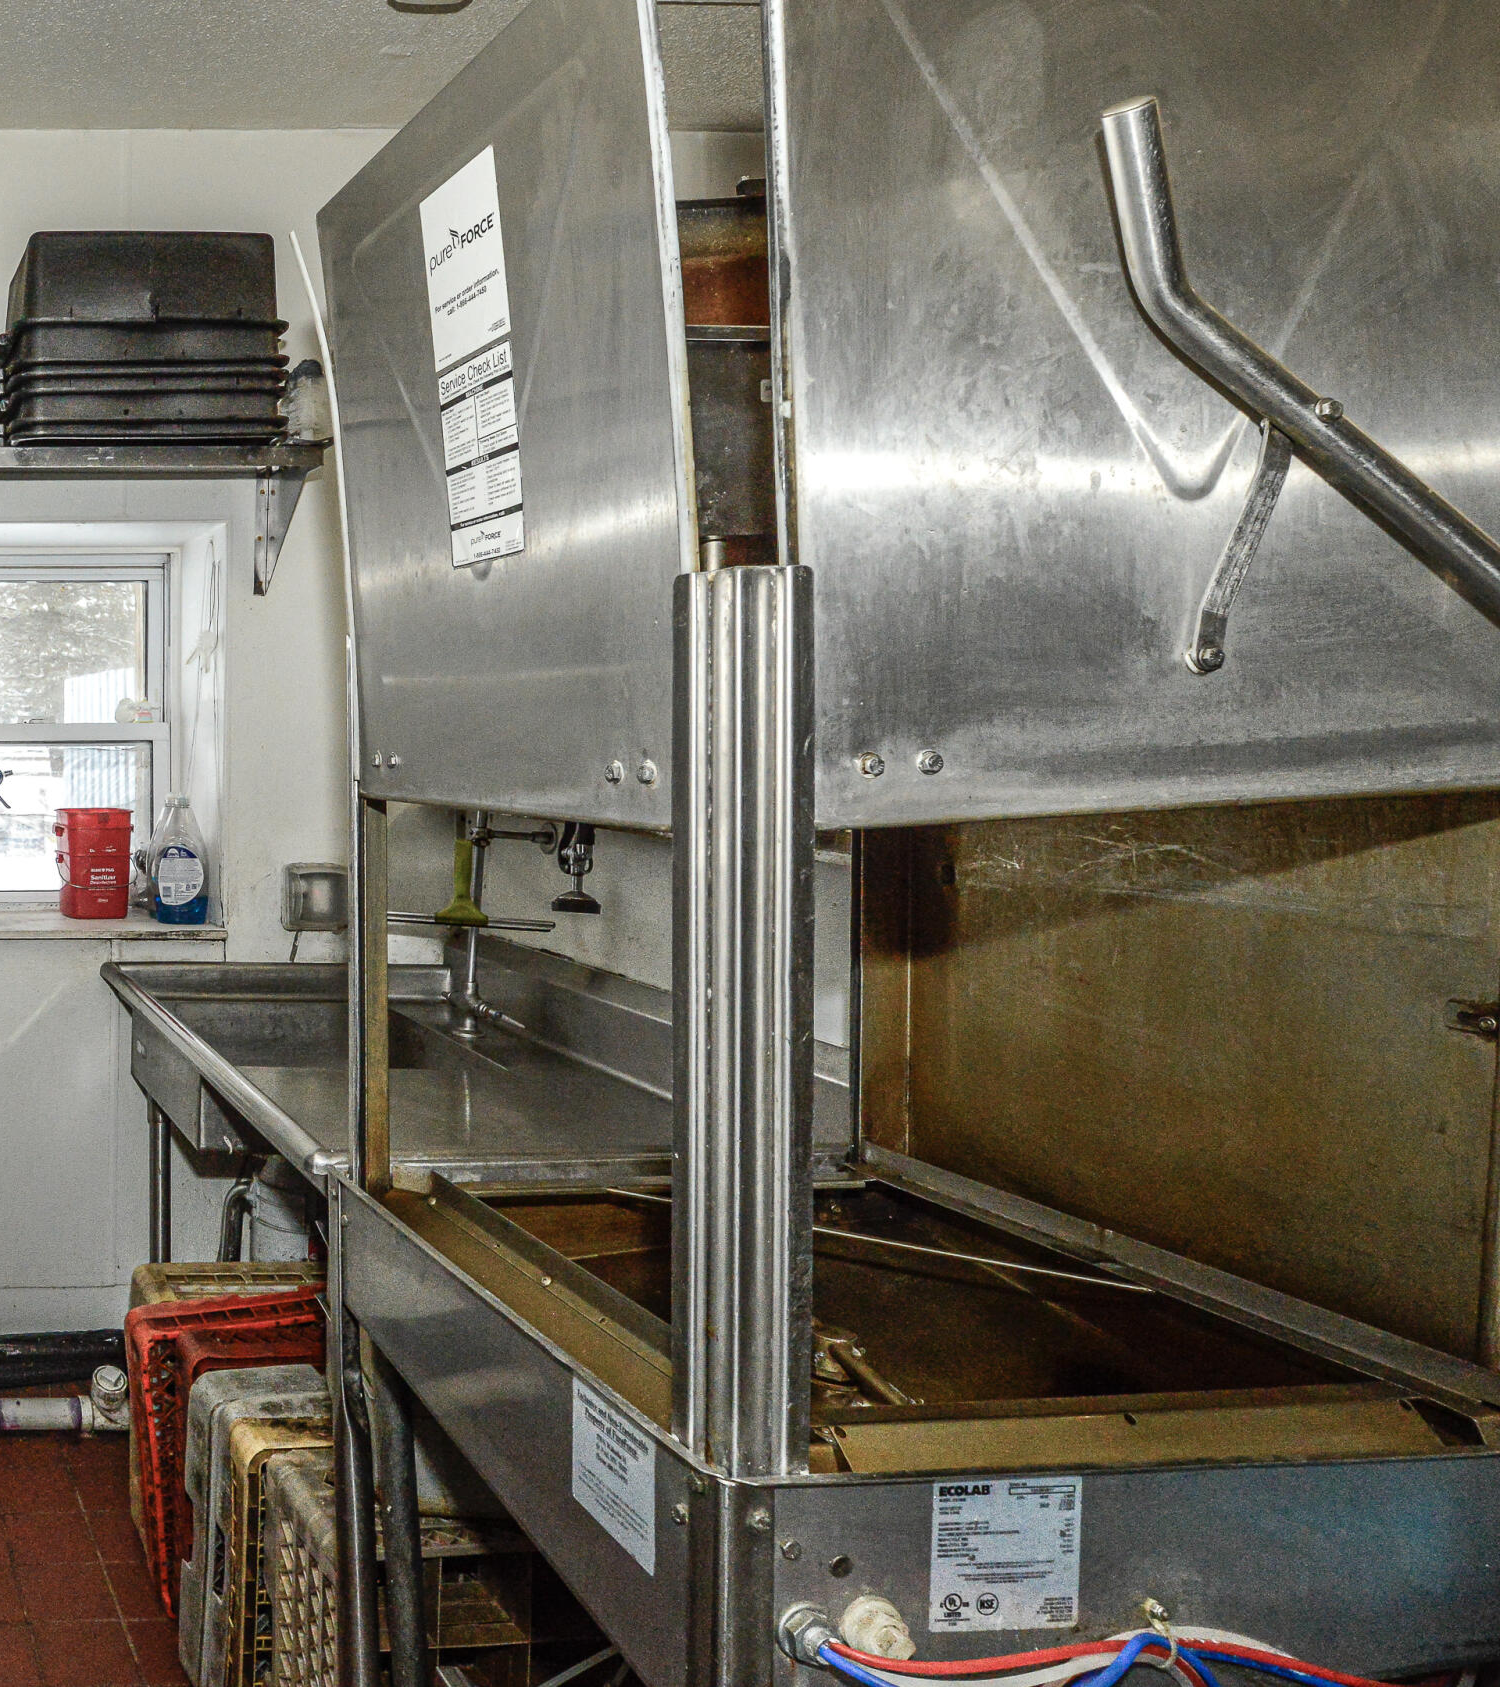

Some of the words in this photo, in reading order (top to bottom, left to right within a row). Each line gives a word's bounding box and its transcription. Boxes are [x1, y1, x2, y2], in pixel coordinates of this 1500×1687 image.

[460, 212, 494, 249] FORCE
[442, 296, 456, 309] service
[461, 284, 474, 297] order
[440, 373, 466, 396] Service
[467, 356, 492, 381] Check
[492, 348, 507, 369] List
[939, 1485, 990, 1496] ECOLAB
